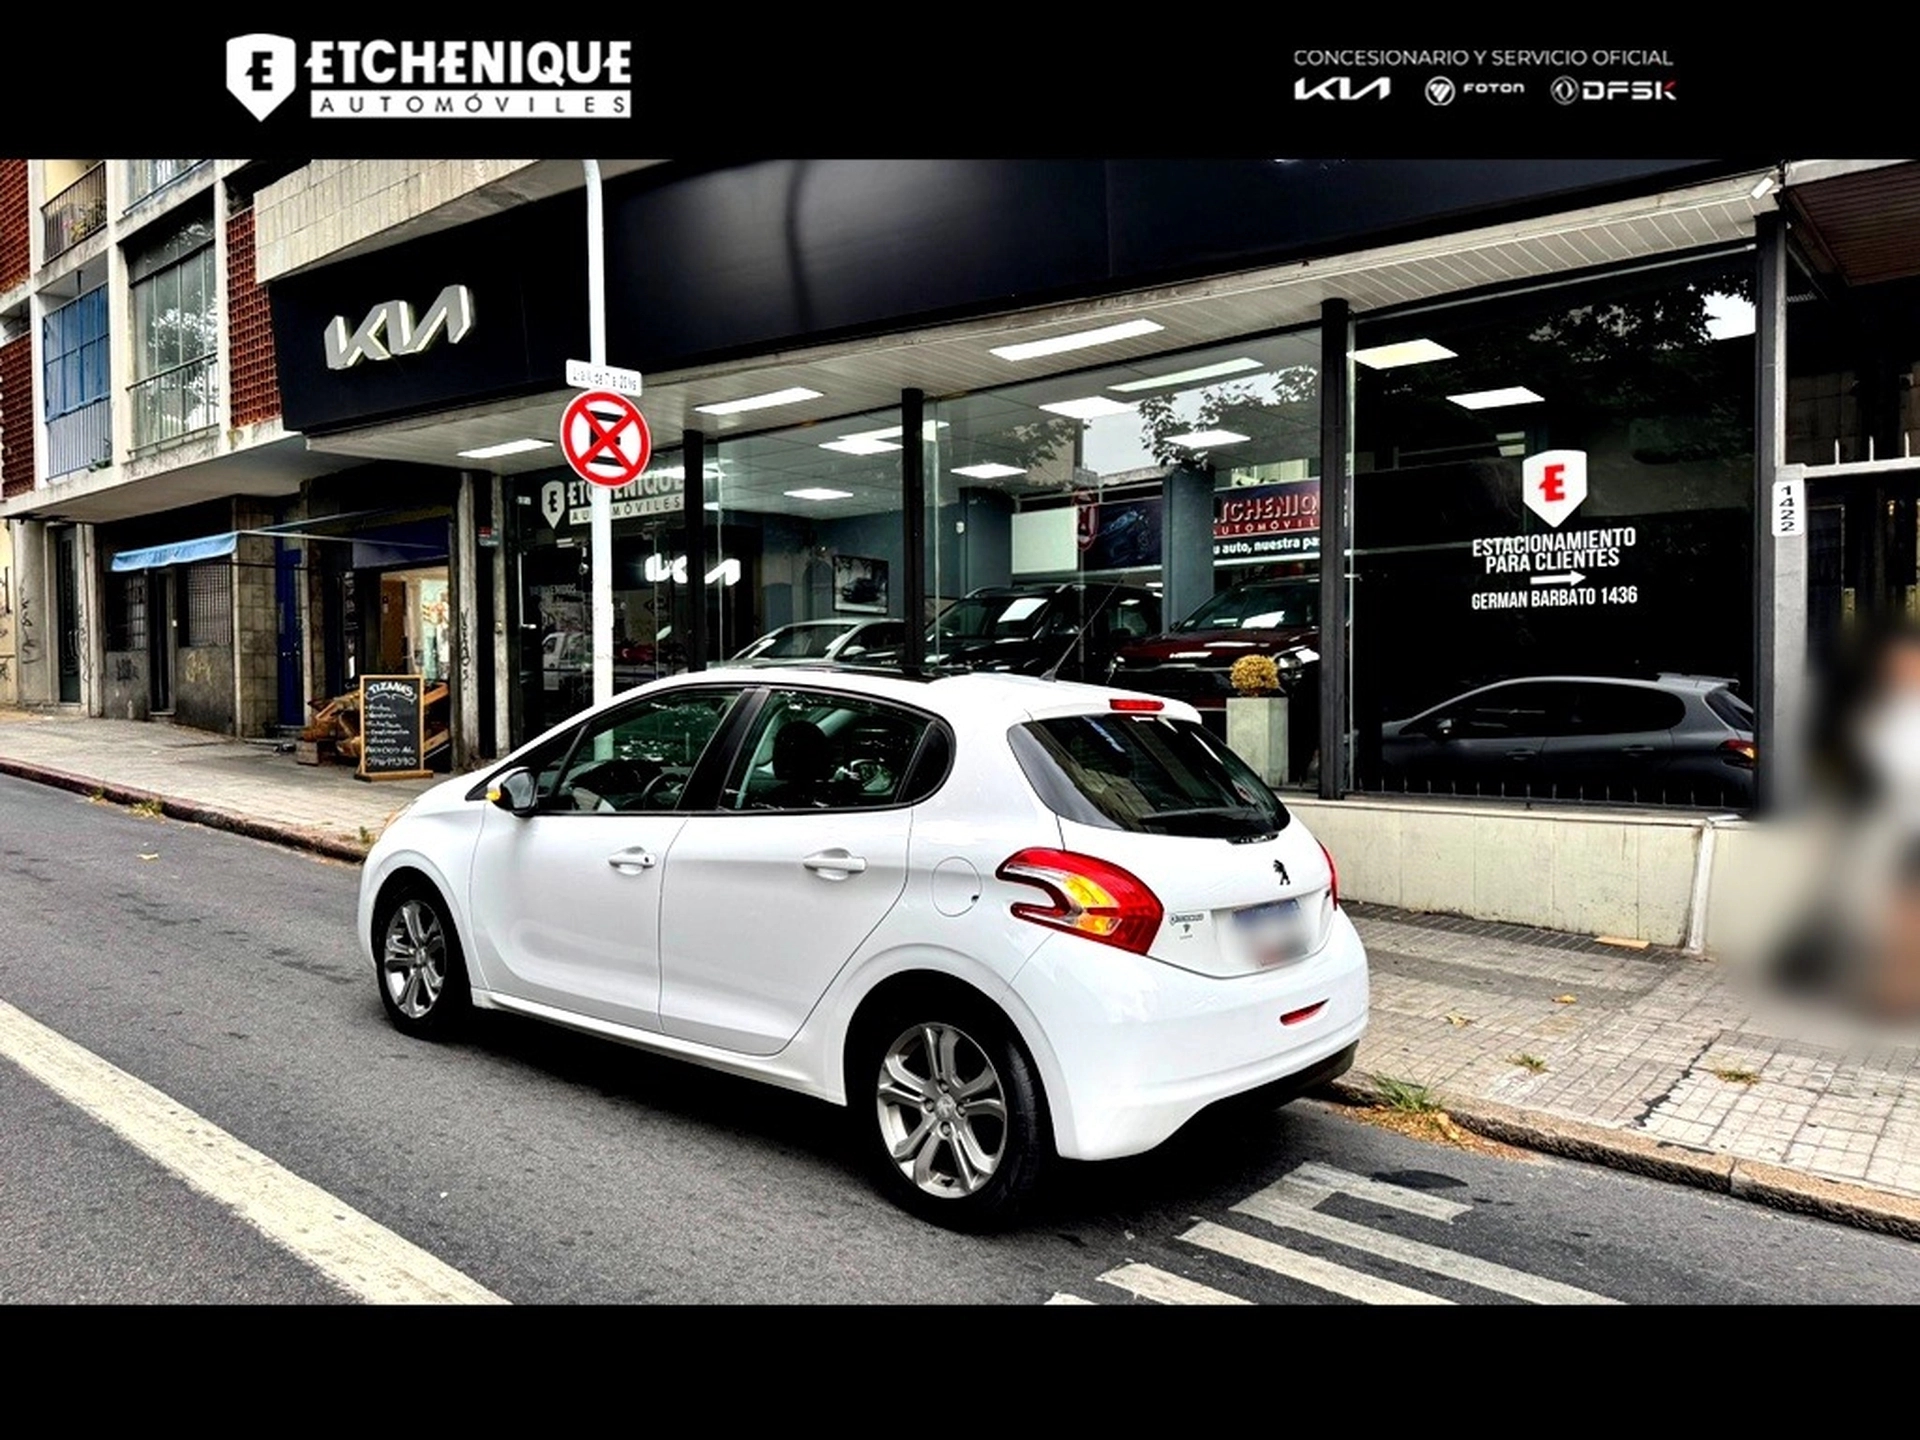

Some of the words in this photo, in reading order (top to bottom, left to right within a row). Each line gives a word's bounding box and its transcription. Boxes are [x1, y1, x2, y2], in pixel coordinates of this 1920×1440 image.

[1779, 485, 1795, 532] 1422
[1222, 542, 1252, 554] auto,
[1254, 537, 1300, 552] nuestra
[1472, 527, 1636, 557] ESTACIONAMIENTO
[1486, 554, 1531, 574] PARA
[1535, 547, 1620, 571] CLIENTES
[1471, 591, 1528, 610] GERMAN
[1531, 587, 1596, 607] BARBATO
[1601, 585, 1638, 604] 1436
